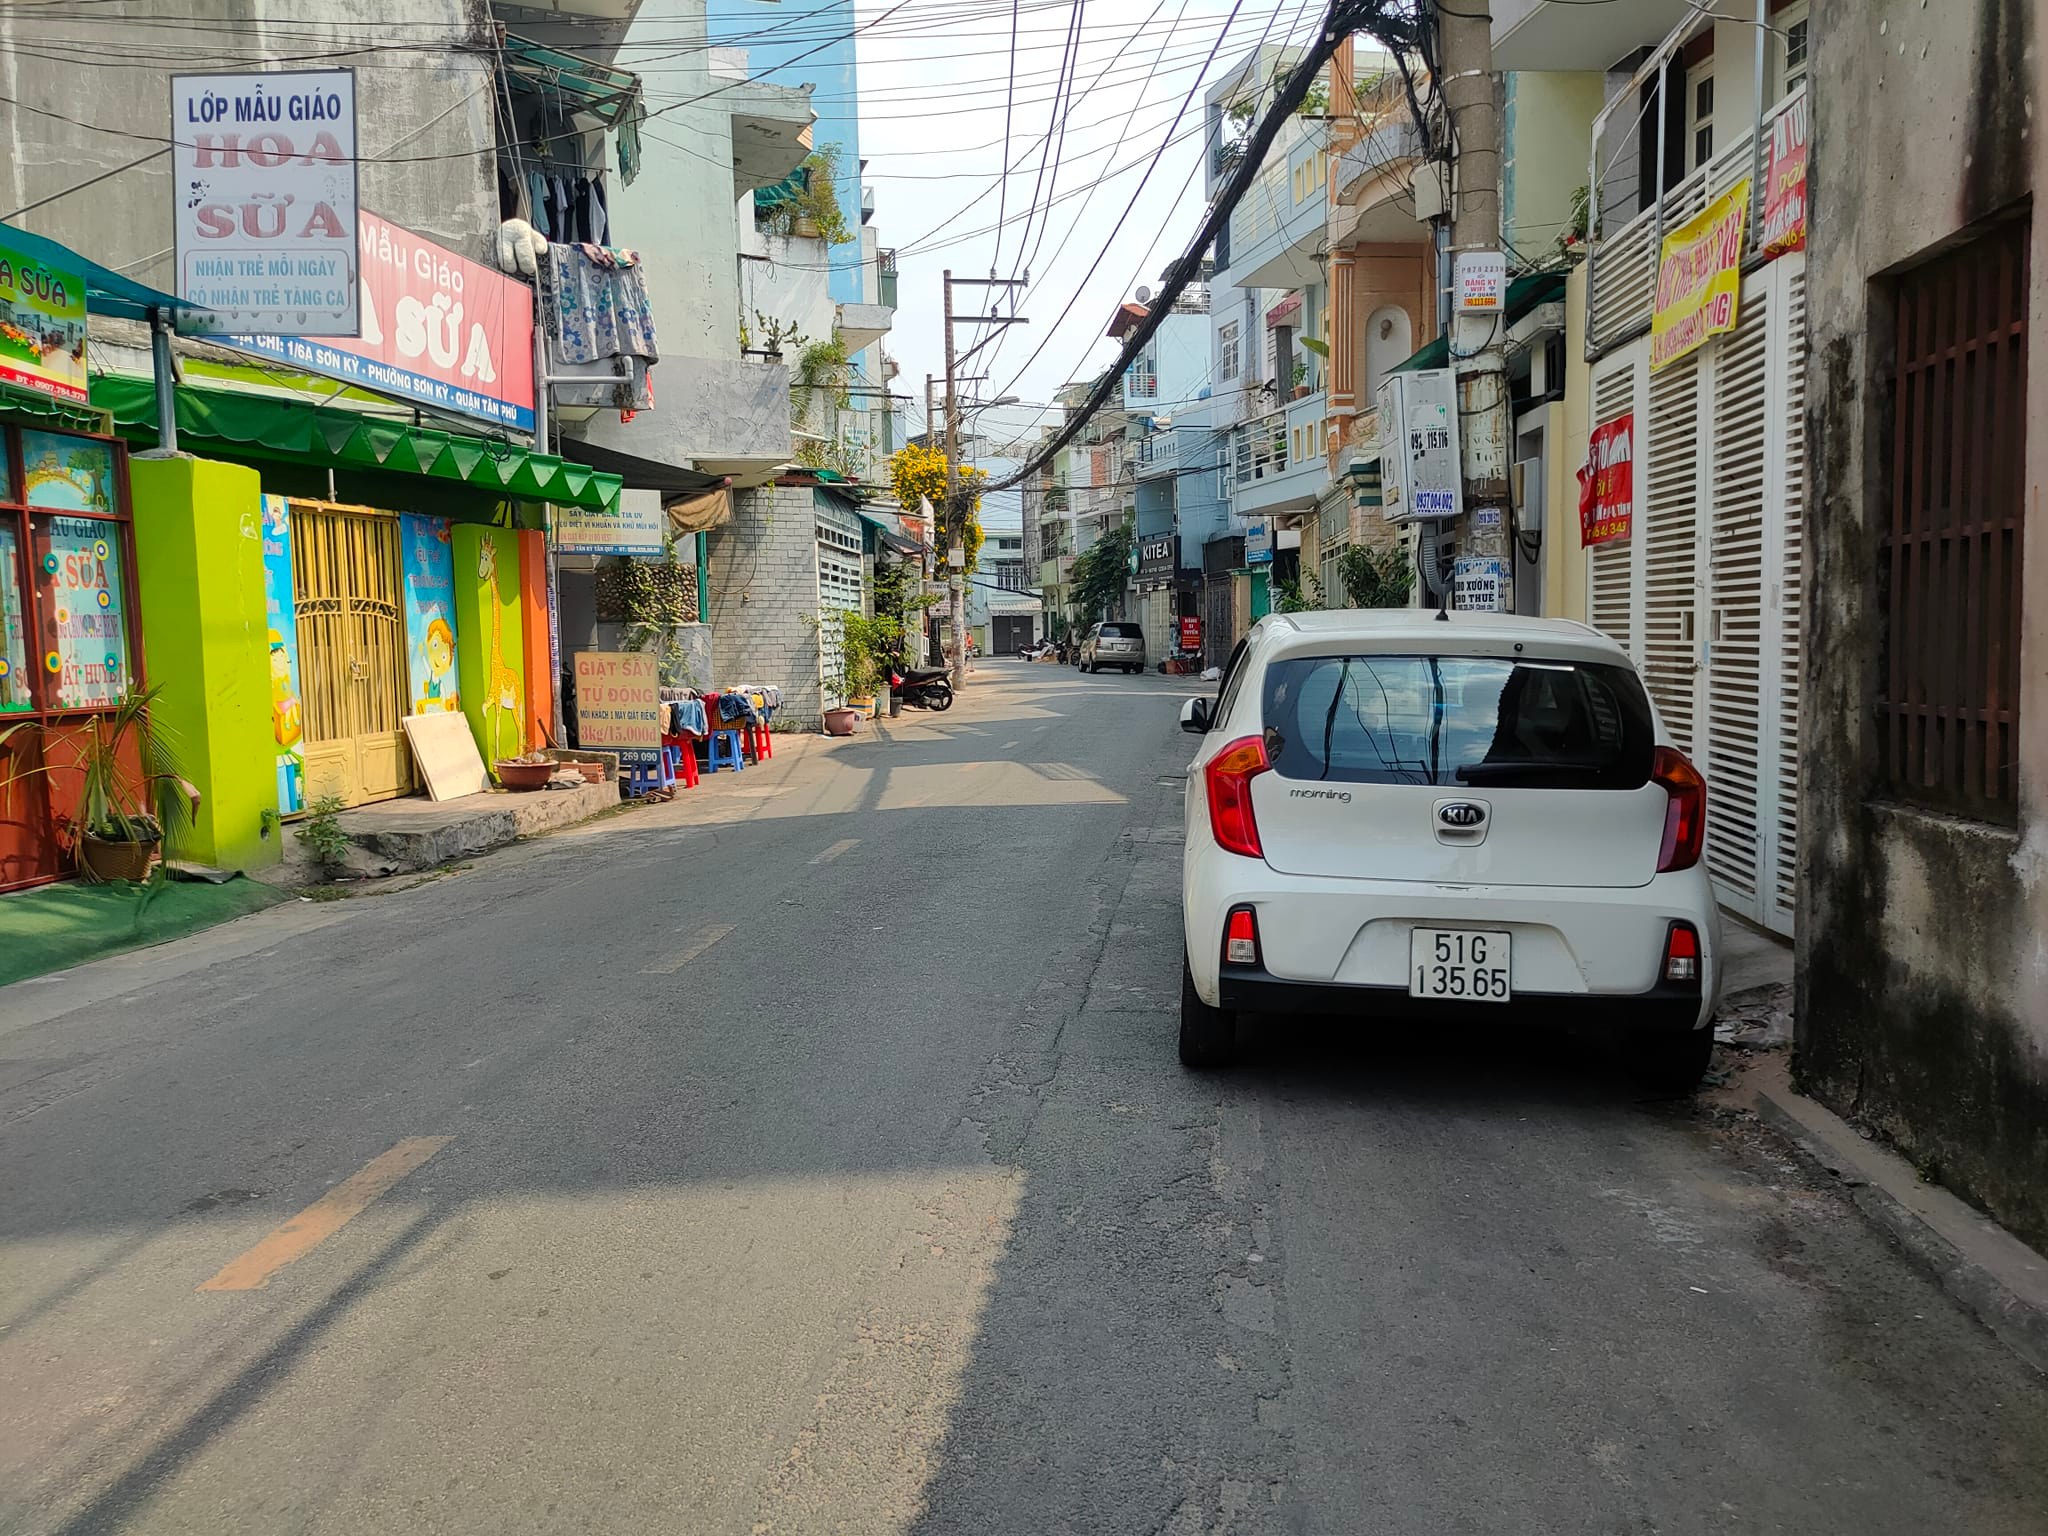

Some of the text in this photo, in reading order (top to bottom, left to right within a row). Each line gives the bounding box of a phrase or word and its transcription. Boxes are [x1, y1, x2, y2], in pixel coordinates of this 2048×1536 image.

[188, 83, 341, 123] LỚP MẪU GIÁO
[192, 131, 349, 168] HOA
[196, 192, 349, 239] SỮA
[196, 256, 234, 281] NHẬN
[238, 253, 264, 277] TRẺ
[298, 256, 336, 277] NGÀY
[360, 220, 464, 293] Mẫu Giáo
[20, 265, 67, 309] SỮA
[211, 286, 249, 310] NHẬN
[253, 283, 279, 306] TRẺ
[326, 289, 345, 306] CA
[395, 291, 497, 384] SỮA
[287, 340, 314, 363] 1/6A
[316, 348, 341, 369] SƠN
[343, 354, 359, 374] KỲ
[367, 363, 412, 392] PHƯỜNG
[413, 377, 434, 396] SƠN
[435, 383, 449, 400] KỲ
[455, 391, 481, 413] QUẬN
[481, 398, 499, 414] TÂN
[501, 406, 517, 421] PHÚ
[66, 546, 109, 588] SỮA
[1143, 541, 1169, 561] KITEA
[579, 656, 654, 681] GIẶT SẤY
[581, 685, 654, 707] TỰ ĐỘNG
[622, 751, 639, 761] 269
[640, 752, 658, 762] 090
[1289, 788, 1352, 804] morning
[1446, 808, 1478, 823] KIA
[1434, 933, 1487, 965] 51G
[1416, 964, 1508, 999] 135.65
